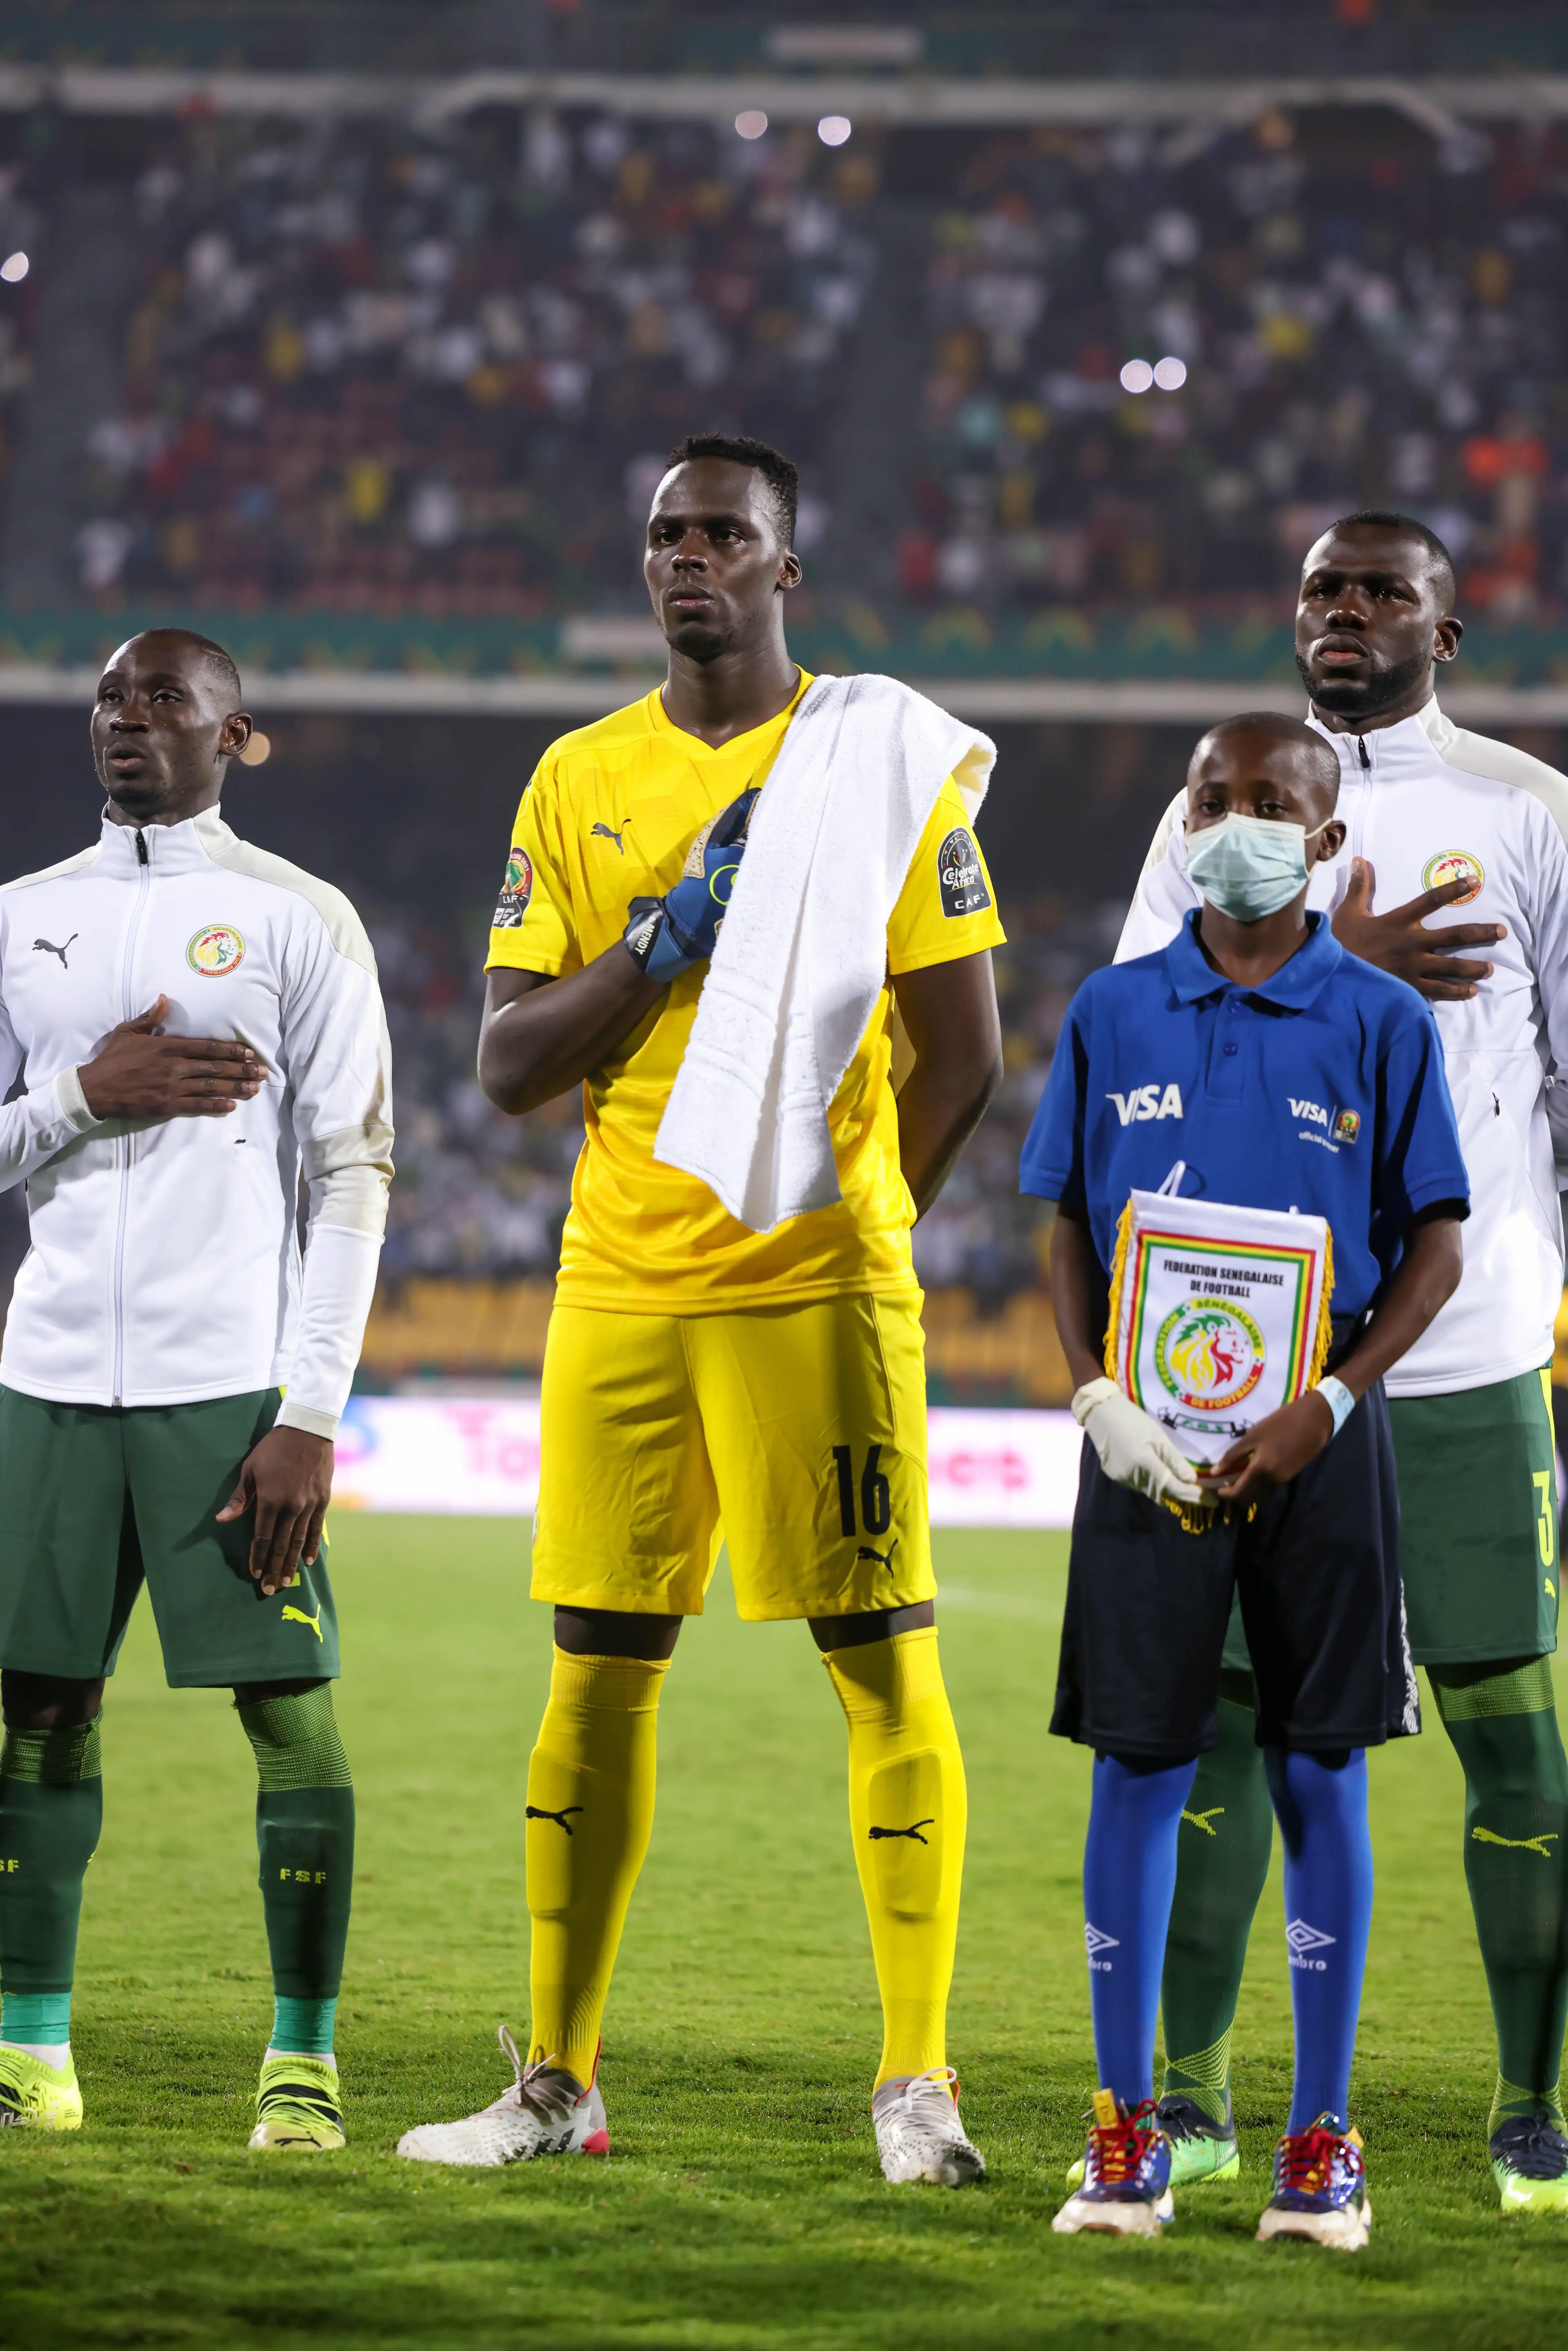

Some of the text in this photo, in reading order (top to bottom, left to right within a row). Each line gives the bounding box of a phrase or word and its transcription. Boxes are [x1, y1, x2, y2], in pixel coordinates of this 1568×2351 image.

[521, 858, 530, 871] 2021
[942, 863, 979, 885] Celebrate
[952, 876, 975, 889] Africa
[503, 895, 519, 903] CAF
[955, 894, 981, 909] CAF
[635, 923, 655, 955] MENDY
[204, 957, 240, 975] DE FOOTBALL
[1105, 1083, 1183, 1127] VISA
[1287, 1097, 1327, 1128] VISA
[1164, 1259, 1284, 1286] FEDERATION SENEGALAISE
[1190, 1279, 1251, 1298] DE FOOTBALL
[1190, 1375, 1258, 1408] DE FOOTBALL
[833, 1444, 890, 1537] 16
[1532, 1470, 1554, 1567] 3
[280, 1868, 326, 1884] FSF
